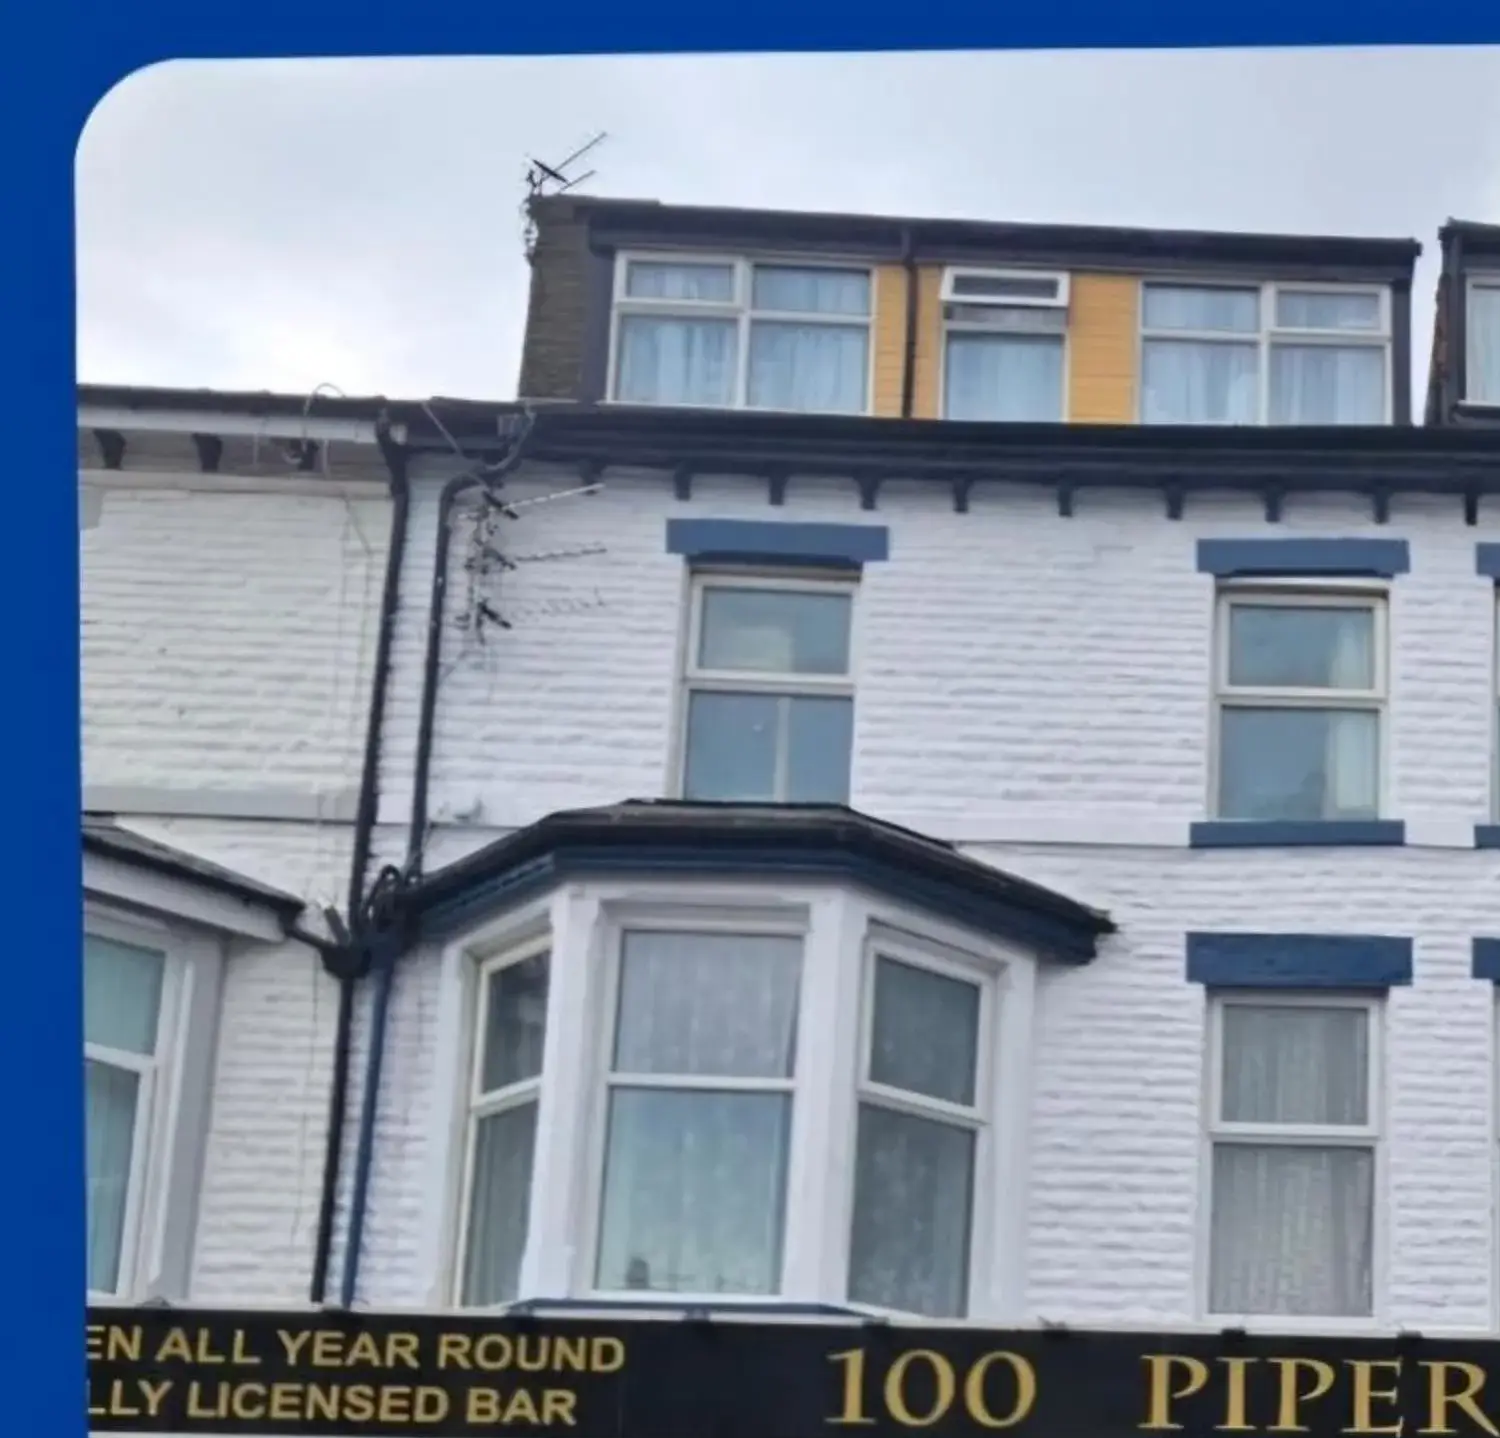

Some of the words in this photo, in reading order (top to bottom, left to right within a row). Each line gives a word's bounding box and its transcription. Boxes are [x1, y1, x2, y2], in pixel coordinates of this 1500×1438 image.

[154, 1327, 261, 1364] ALL
[276, 1330, 420, 1368] YEAR
[436, 1333, 627, 1374] ROUND
[186, 1381, 450, 1424] LICENSED
[464, 1385, 578, 1426] BAR
[825, 1349, 1038, 1428] 100
